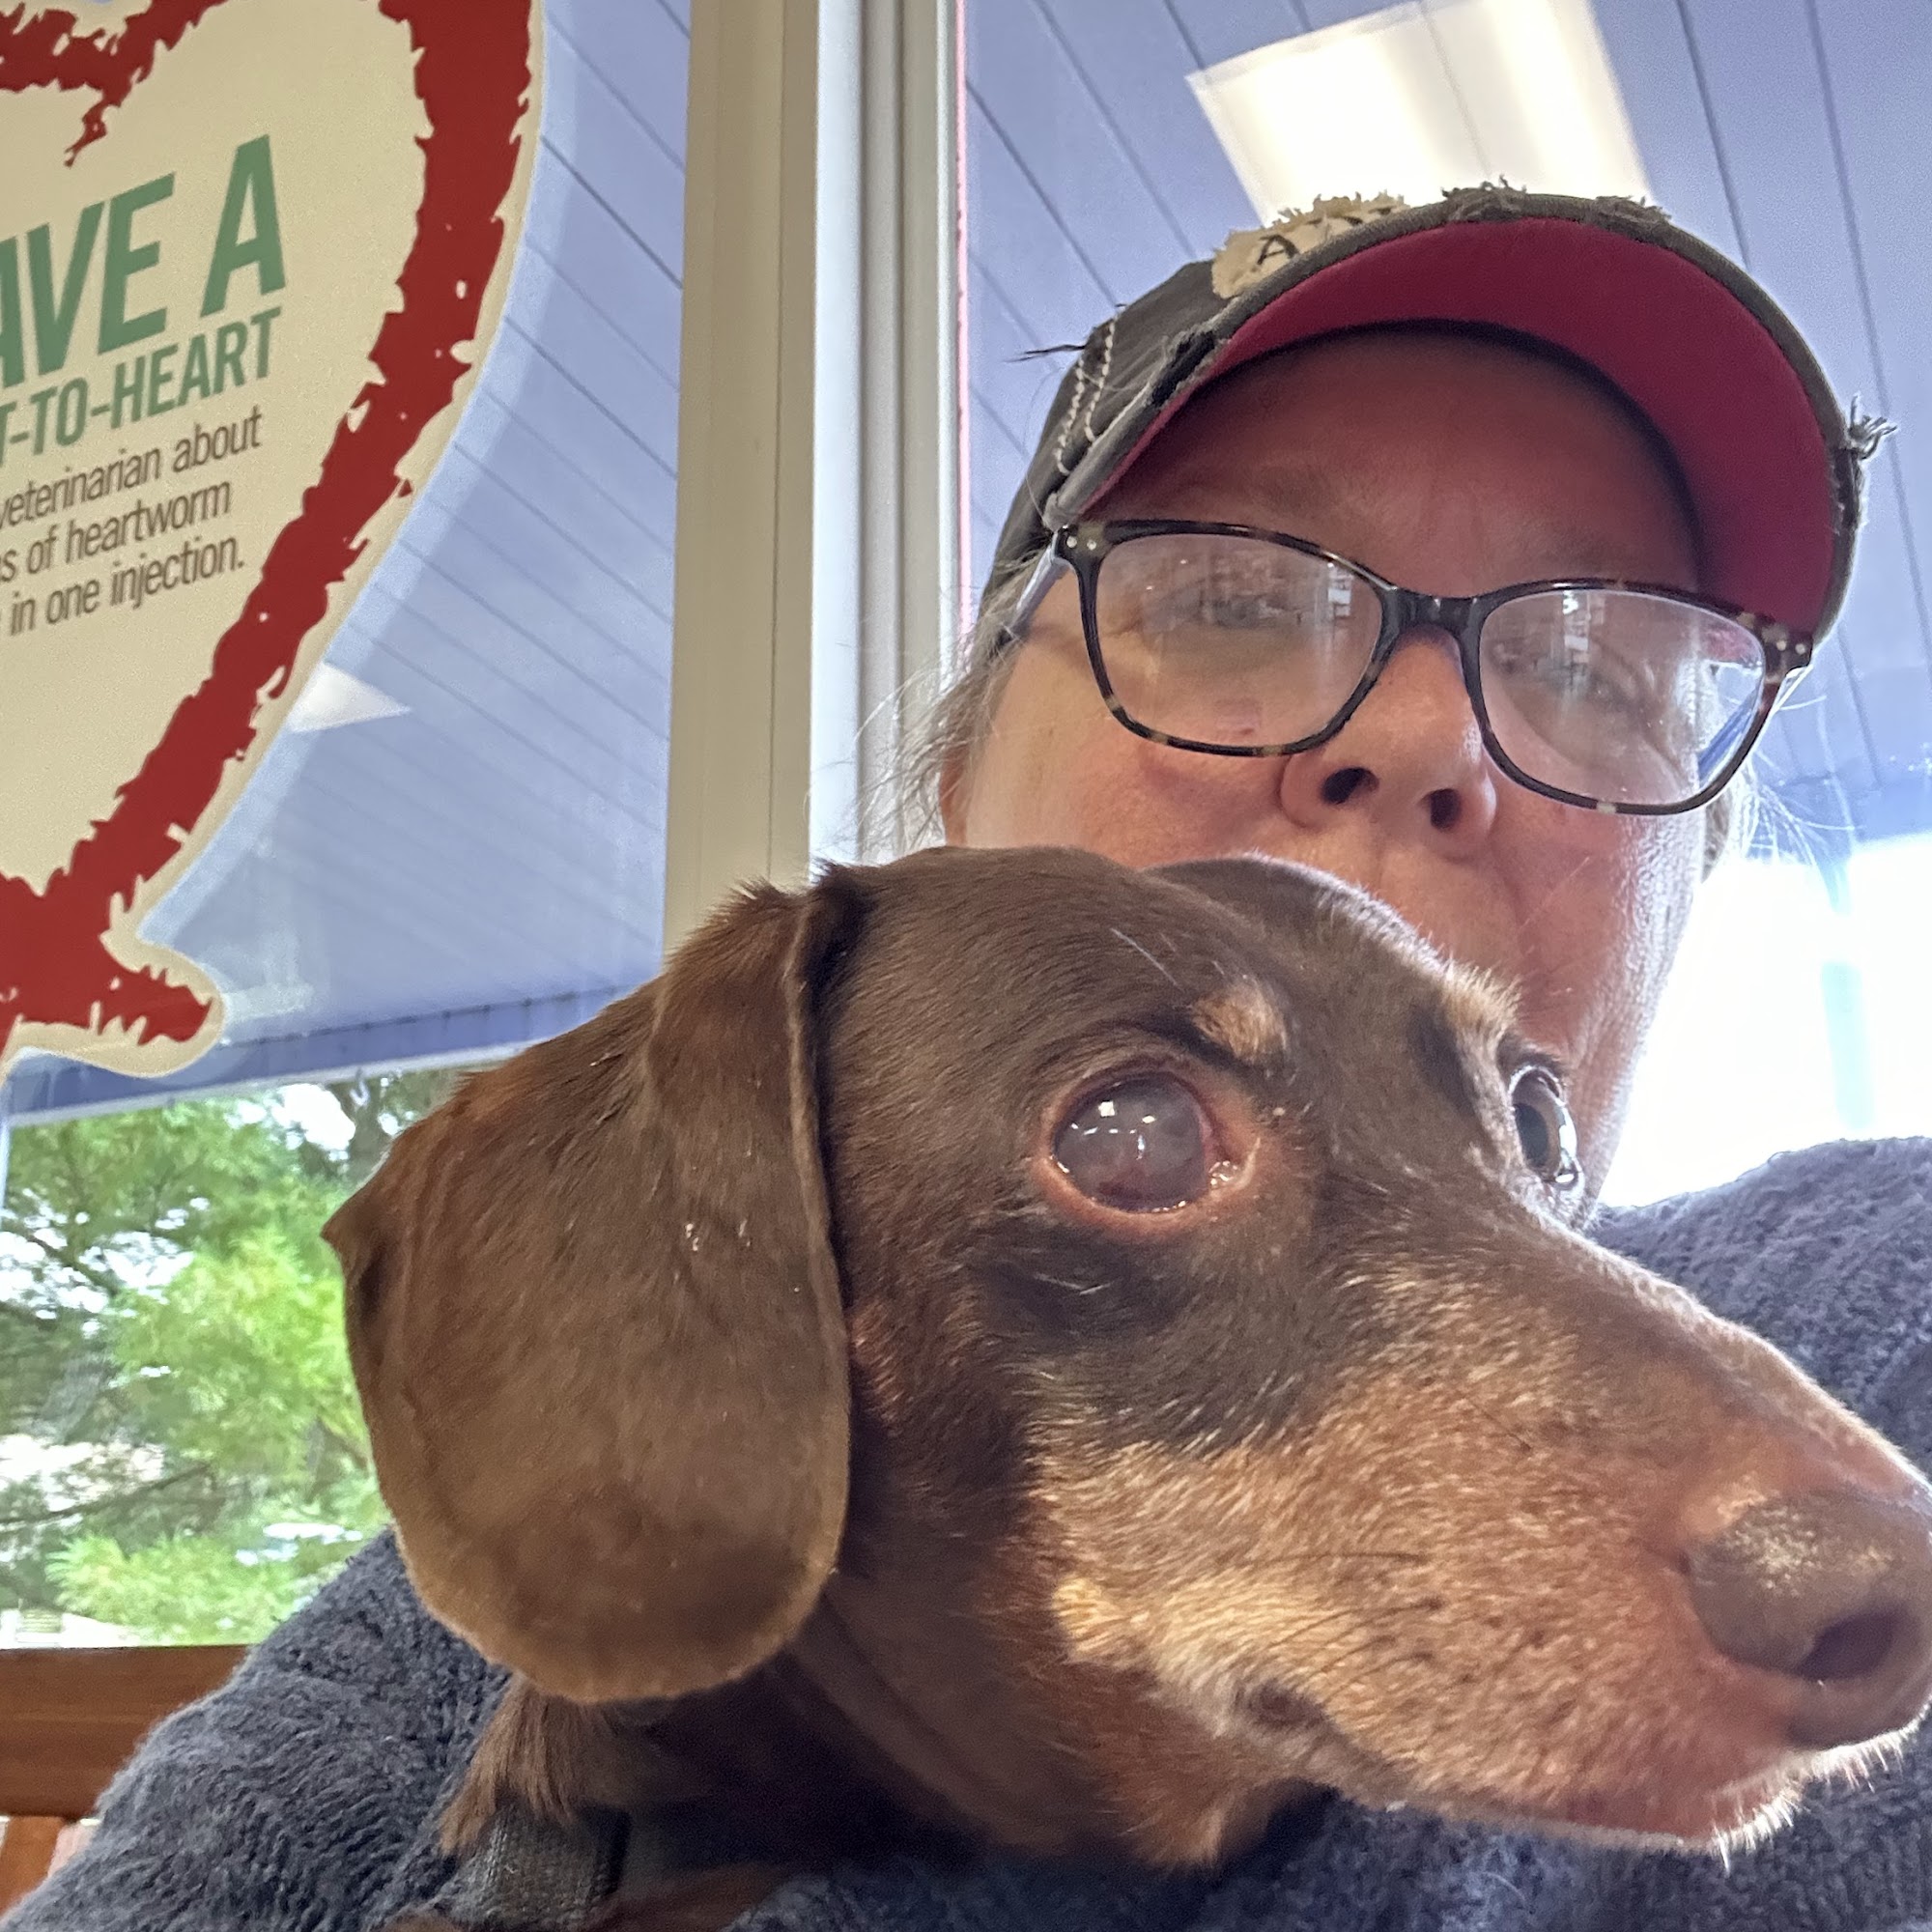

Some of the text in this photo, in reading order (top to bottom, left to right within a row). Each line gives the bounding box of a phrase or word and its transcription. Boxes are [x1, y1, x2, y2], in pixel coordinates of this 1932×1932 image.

[200, 133, 287, 319] A
[172, 405, 262, 473] about
[0, 481, 232, 583] s of heartworm
[11, 534, 245, 637] in one injection.
